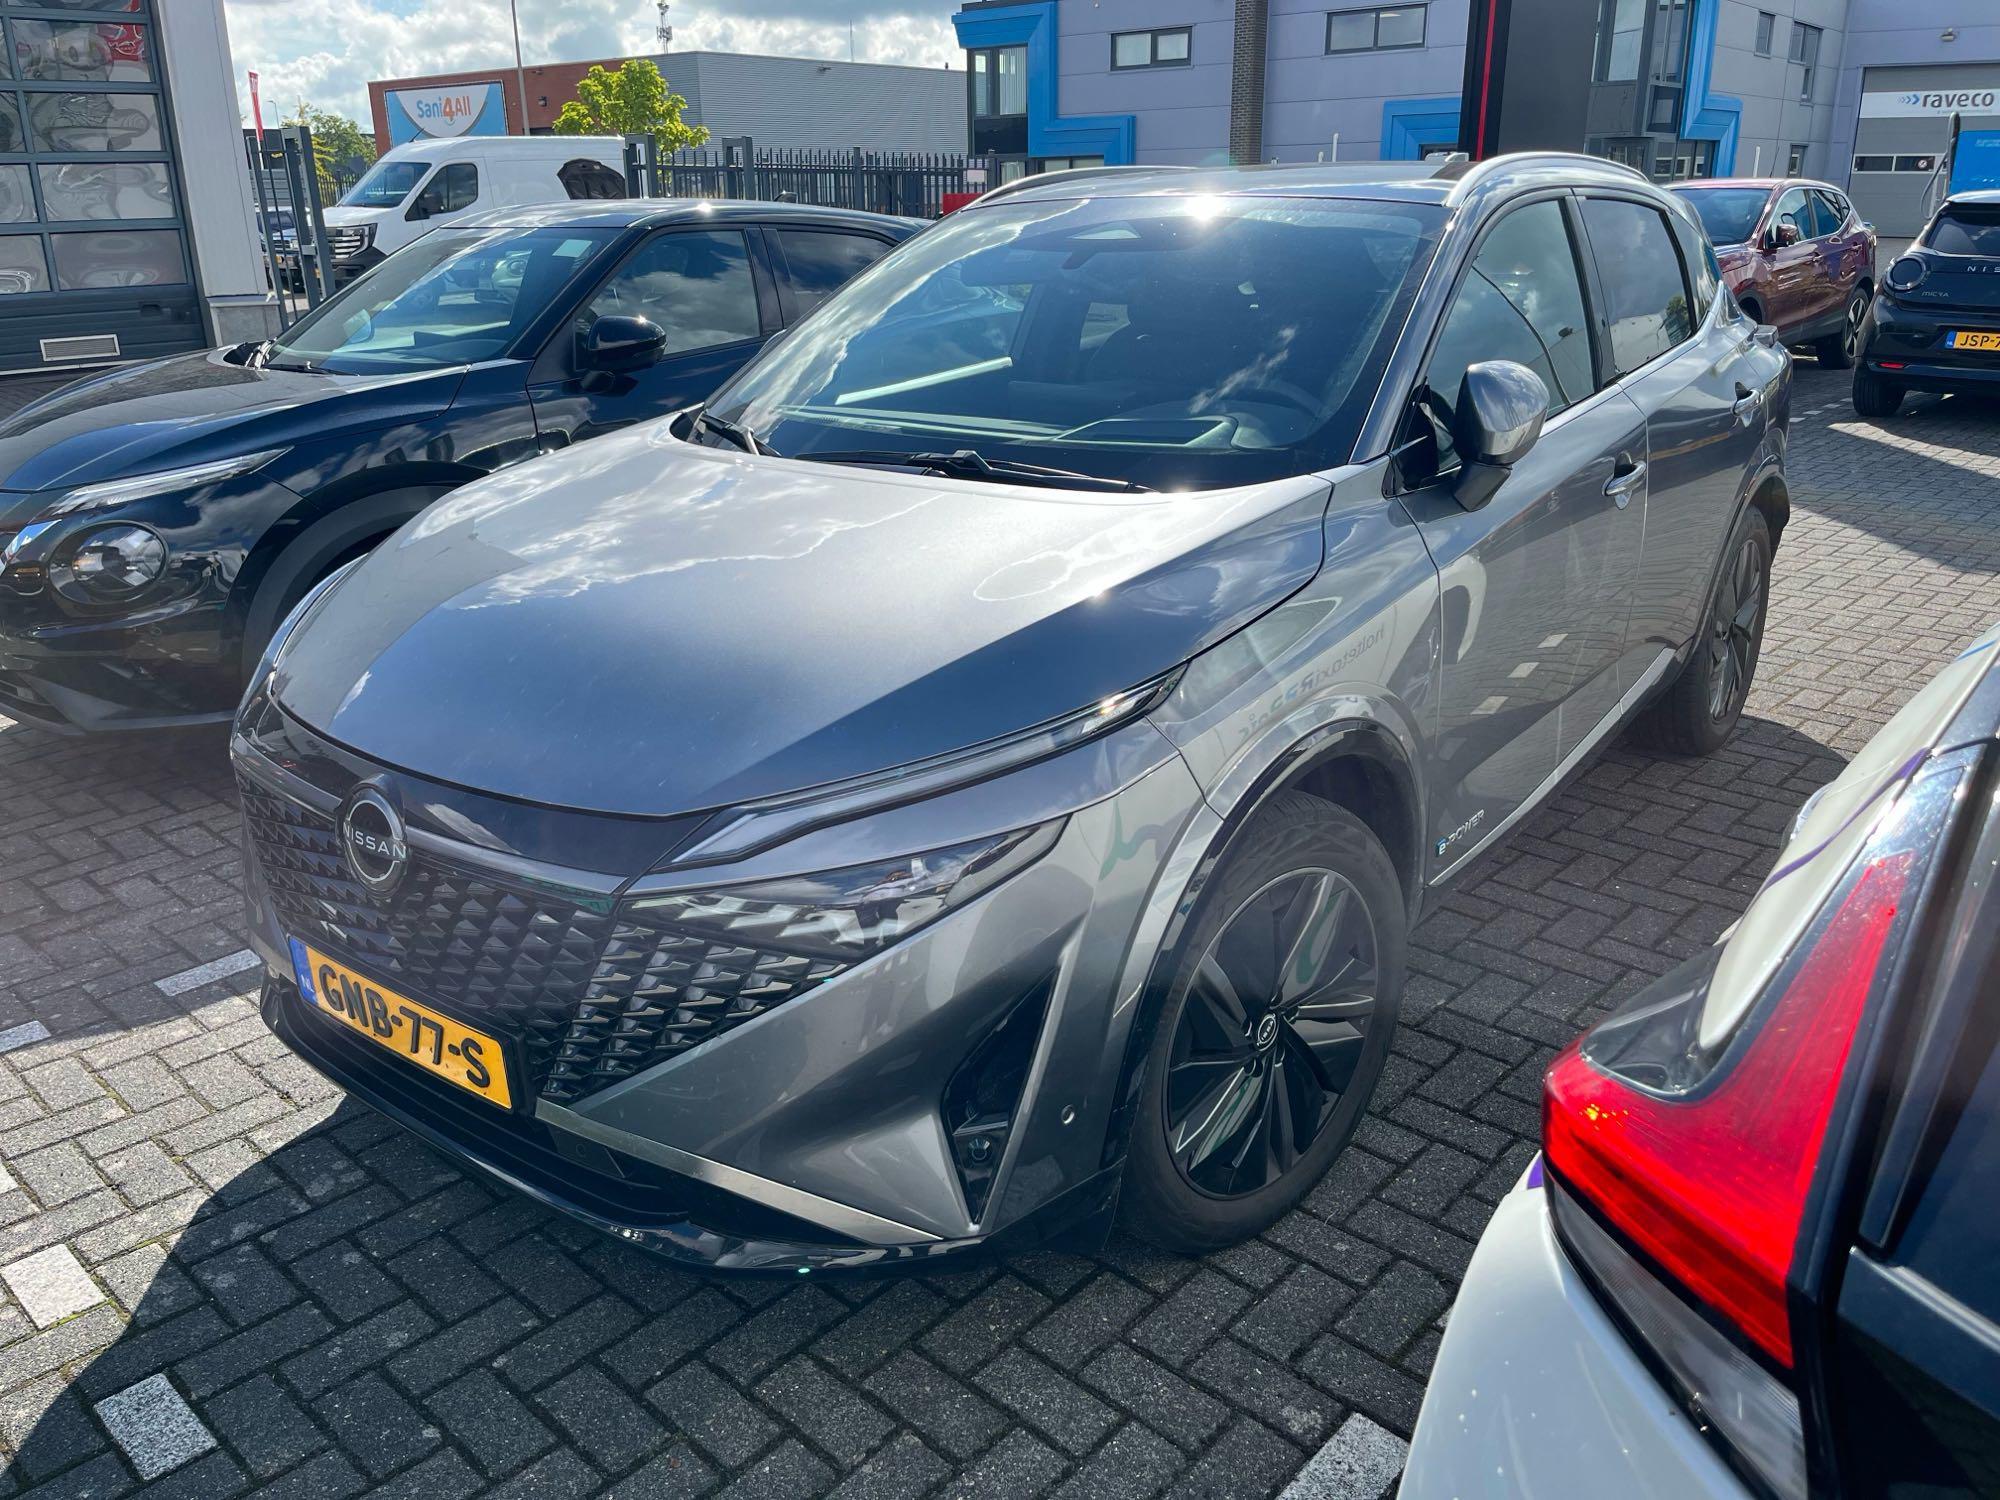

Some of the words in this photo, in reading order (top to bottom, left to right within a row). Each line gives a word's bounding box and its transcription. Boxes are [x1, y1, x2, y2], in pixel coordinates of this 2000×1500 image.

[416, 95, 472, 122] Sani4All
[1922, 92, 1995, 109] raveco
[343, 821, 407, 859] NISSAN
[301, 974, 315, 994] NL
[318, 963, 491, 1088] GNB-77-S
